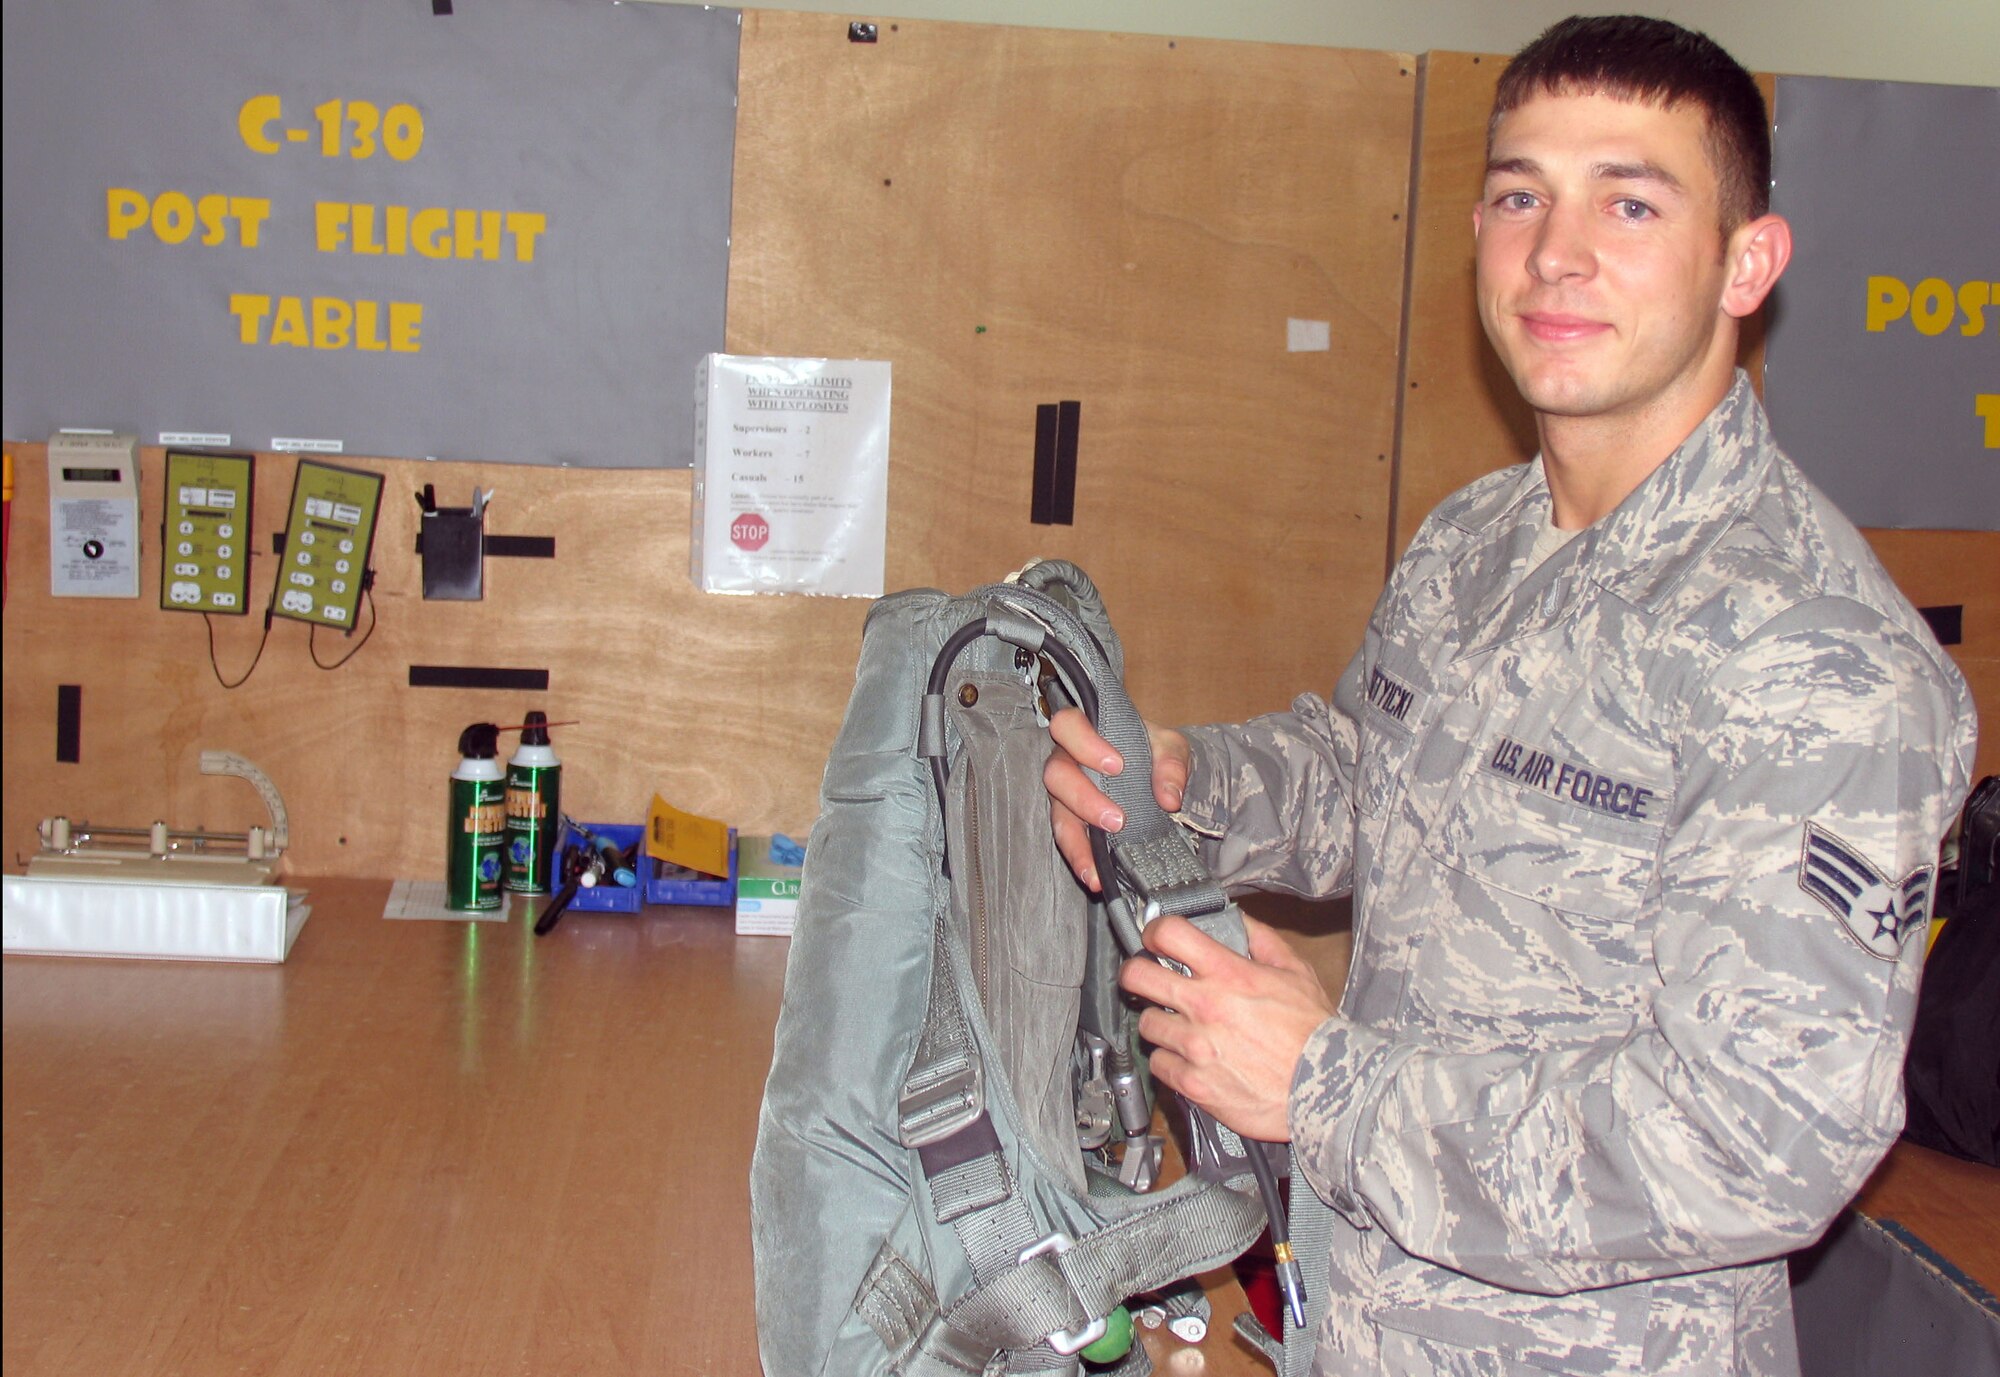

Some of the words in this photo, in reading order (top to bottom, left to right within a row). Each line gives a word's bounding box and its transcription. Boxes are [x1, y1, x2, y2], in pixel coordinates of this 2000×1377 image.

[239, 96, 423, 160] C-130
[108, 188, 270, 246] POST
[316, 203, 545, 261] FLIGHT
[1865, 276, 2000, 336] POS
[230, 294, 421, 352] TABLE
[814, 377, 853, 388] LIMITS
[748, 387, 781, 397] WHEN
[784, 388, 849, 400] OPERATING
[748, 399, 778, 410] WITH
[779, 400, 849, 412] EXPLOSIVES
[733, 423, 787, 434] Supervisors
[732, 448, 773, 457] Workers
[731, 473, 767, 482] Casuals
[732, 525, 768, 540] STOP
[1520, 750, 1555, 790] AIR
[1555, 763, 1654, 819] FORCE
